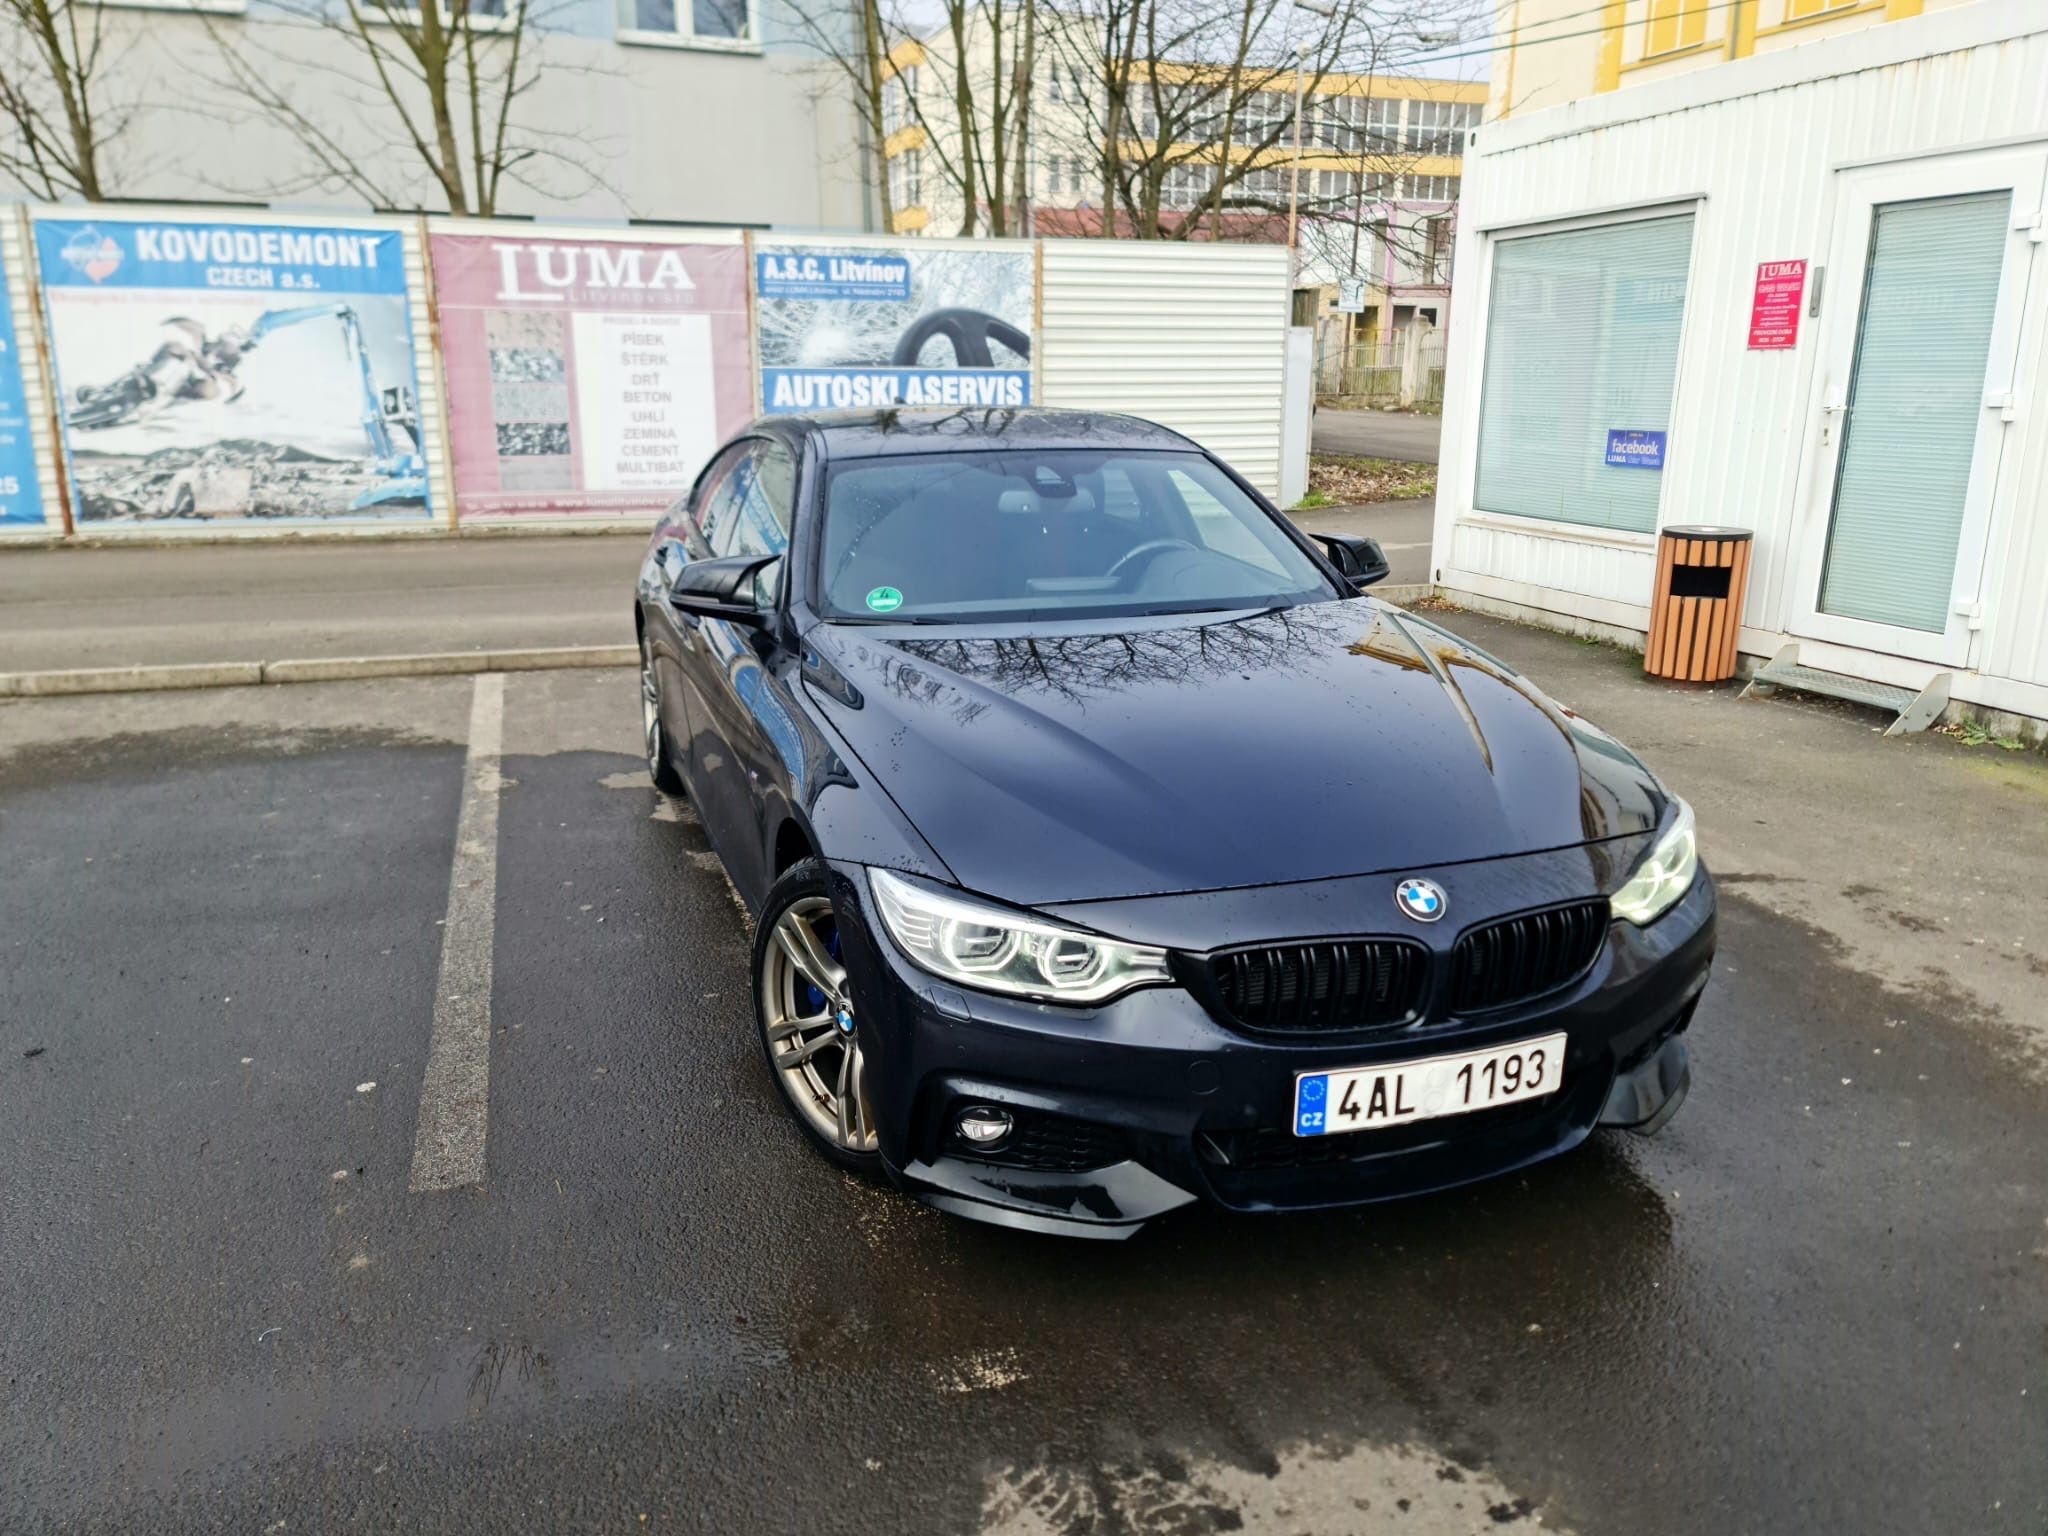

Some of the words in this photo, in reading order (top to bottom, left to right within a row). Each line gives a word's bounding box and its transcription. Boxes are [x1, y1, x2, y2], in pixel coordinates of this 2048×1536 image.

[135, 228, 380, 267] KOVODEMONT
[206, 266, 274, 287] CZECH
[280, 272, 321, 289] a.s.
[491, 243, 696, 301] LUMA
[764, 256, 825, 281] A.S.C.
[830, 259, 906, 283] Litvínov
[1759, 261, 1803, 281] LUMA
[622, 391, 672, 403] BETON
[623, 428, 677, 440] ZEMINA
[621, 444, 679, 457] CEMENT
[1612, 438, 1659, 455] facebook
[616, 460, 685, 474] MULTIBAT
[1607, 455, 1626, 463] LUMA
[1399, 880, 1438, 897] BMW
[1338, 1072, 1416, 1121] 4AL
[1457, 1048, 1545, 1105] 1193
[1301, 1112, 1323, 1127] CZ
